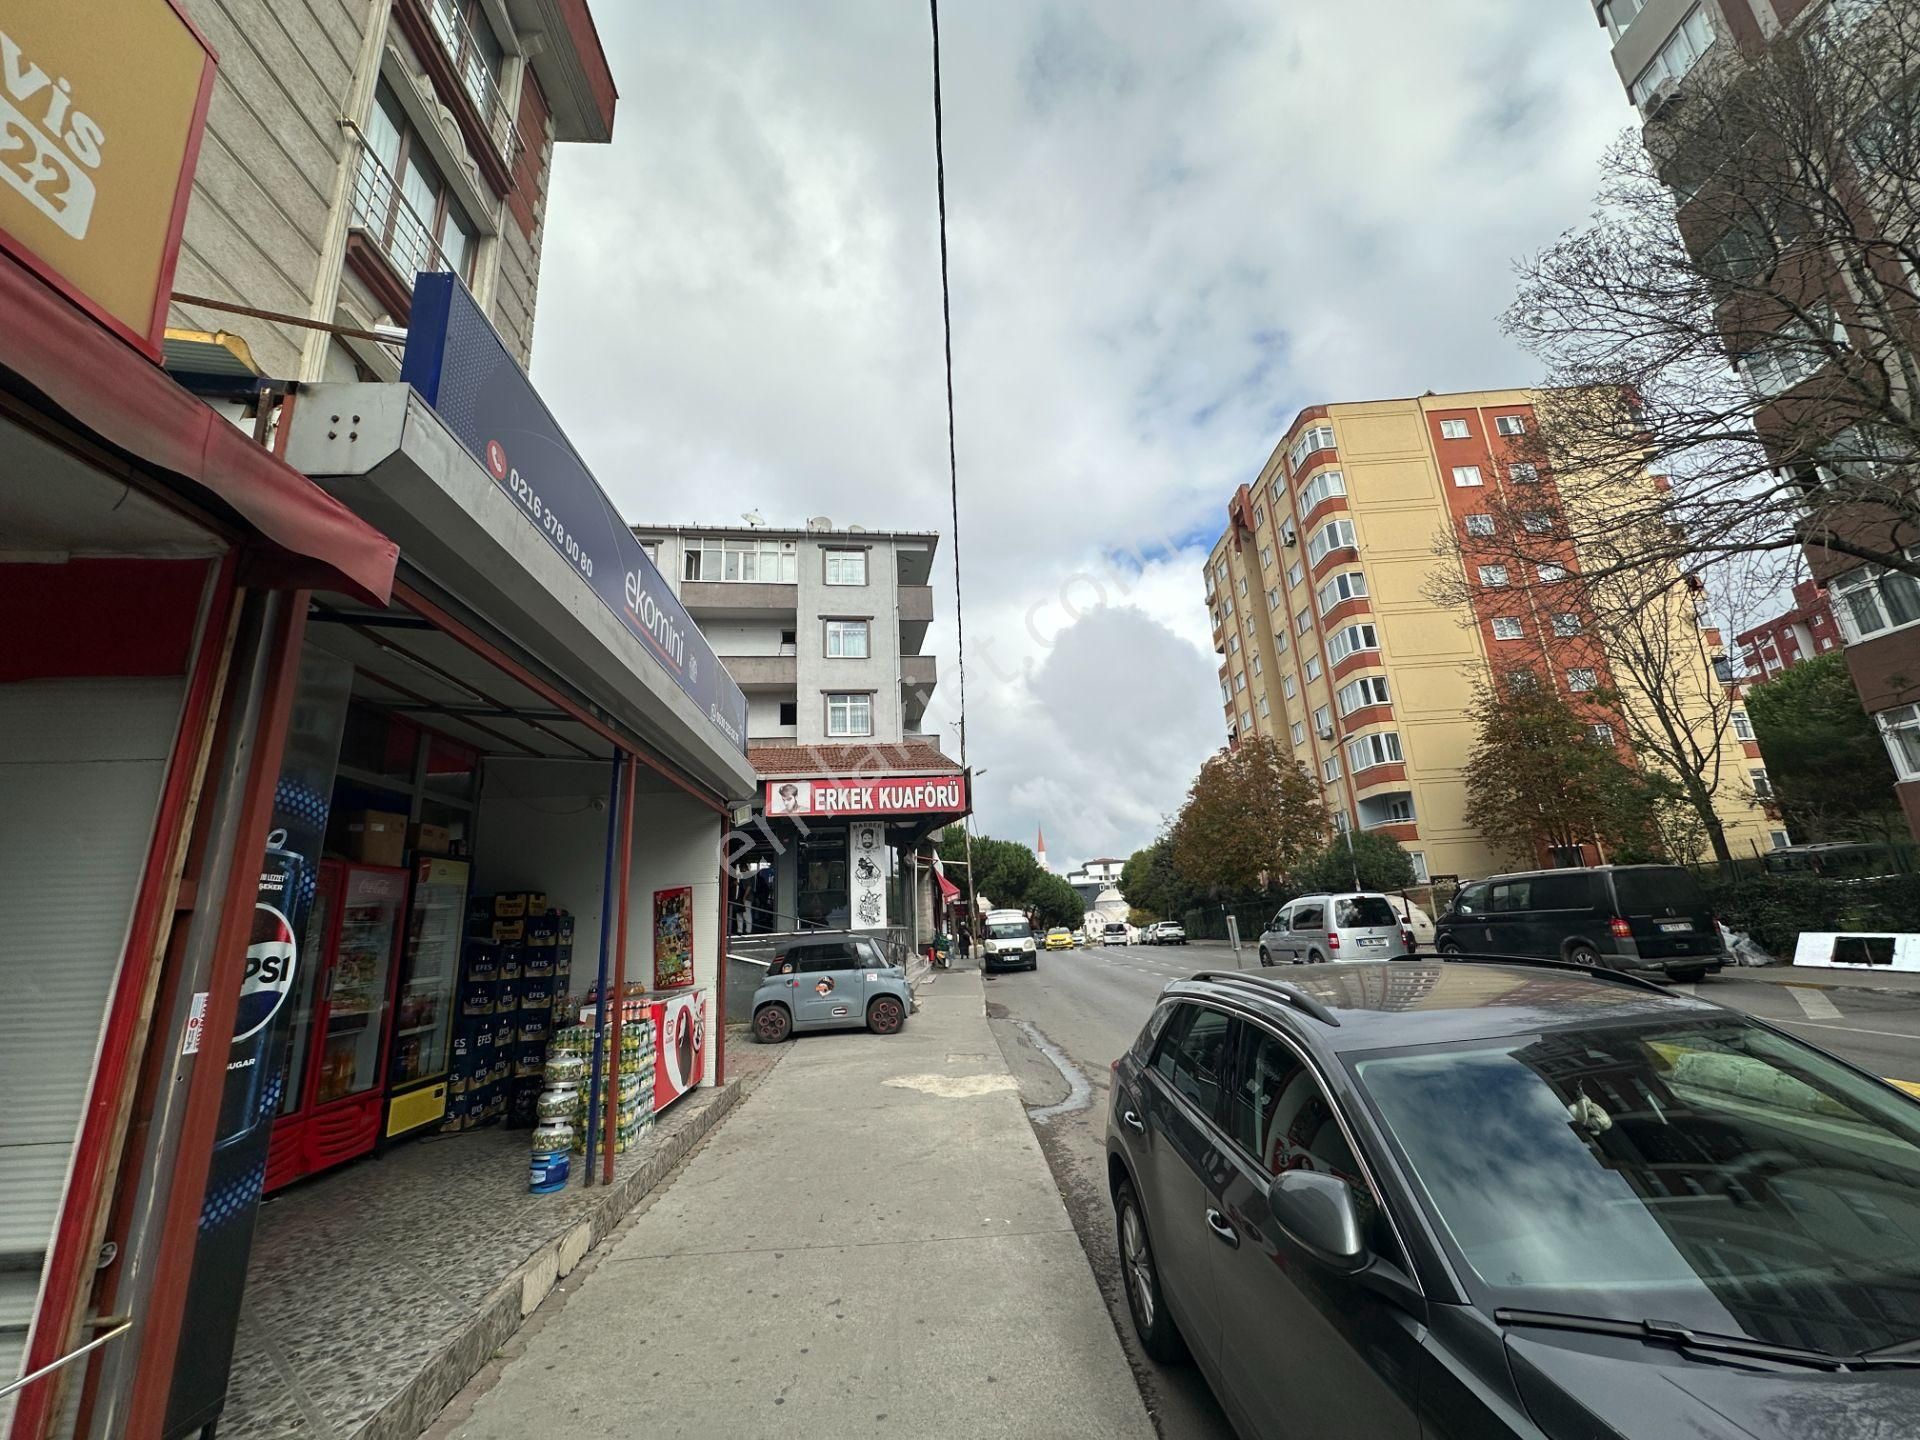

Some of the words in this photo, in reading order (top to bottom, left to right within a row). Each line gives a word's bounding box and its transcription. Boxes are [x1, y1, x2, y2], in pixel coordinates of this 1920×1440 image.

[509, 468, 542, 518] 0216
[543, 509, 565, 544] 378
[566, 534, 580, 563] 00
[581, 551, 594, 578] 80
[624, 569, 685, 668] ekomini
[814, 788, 874, 811] ERKEK
[879, 781, 960, 809] KUAFÖRÜ
[243, 955, 290, 985] PSI
